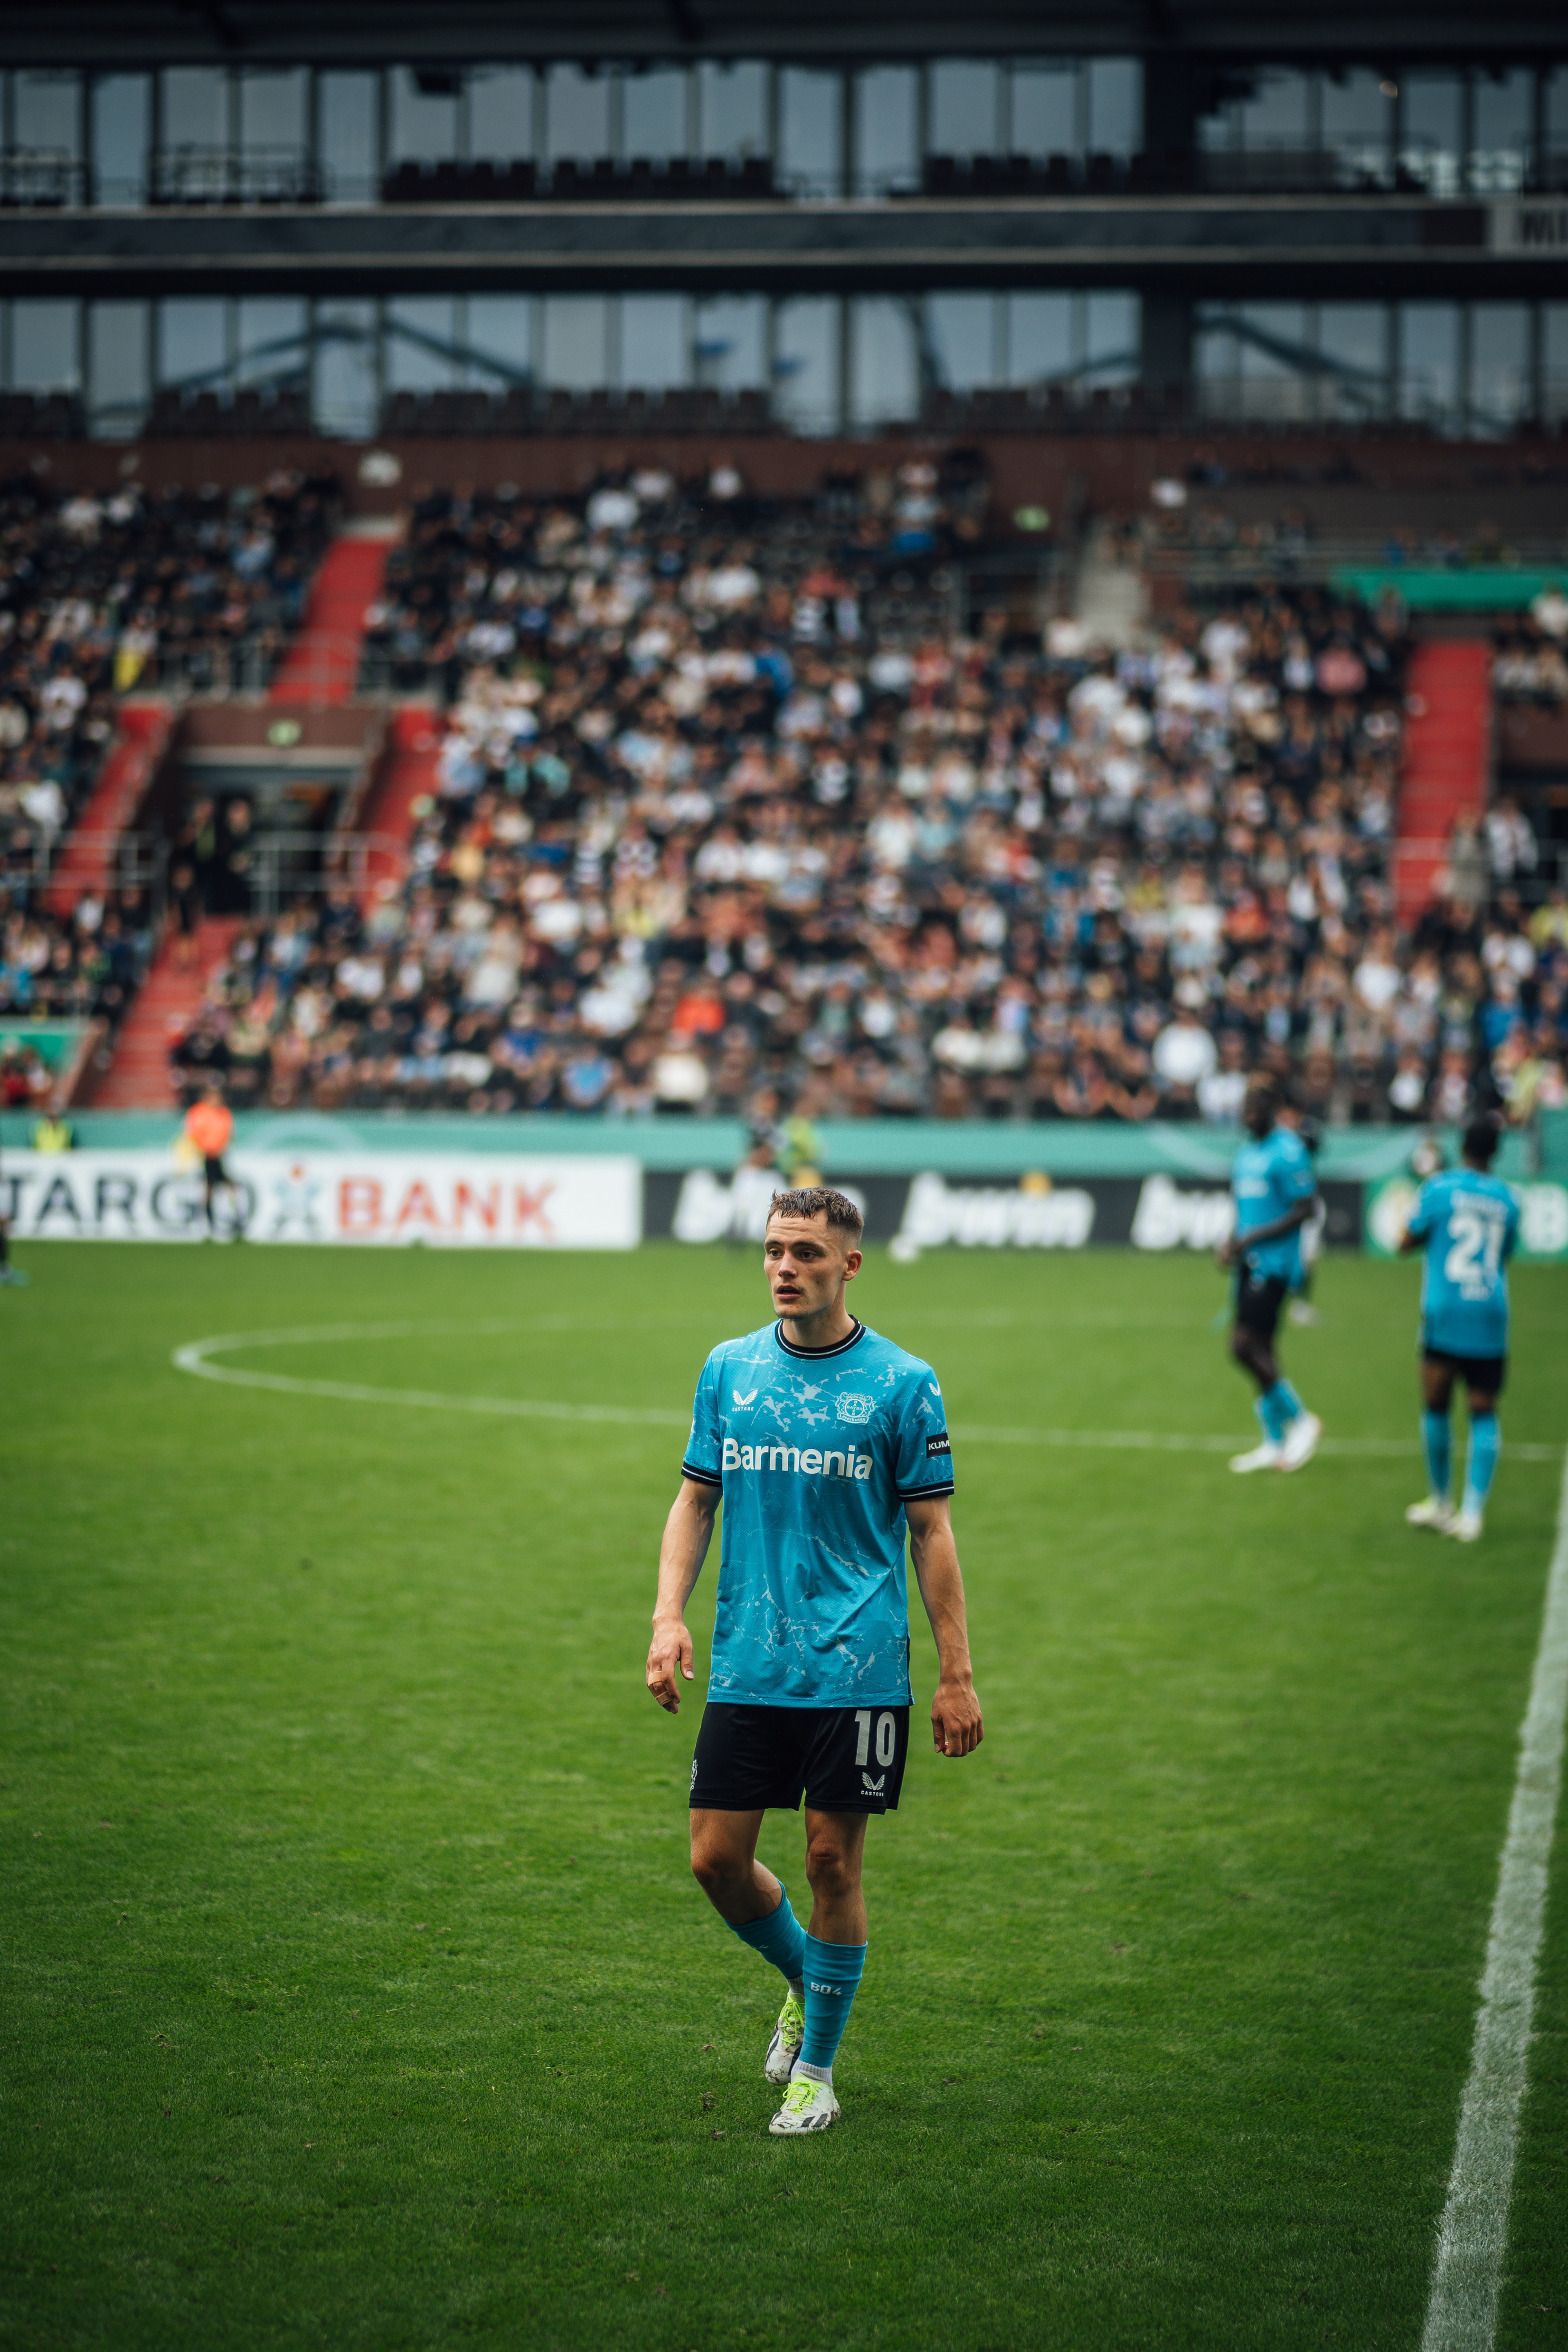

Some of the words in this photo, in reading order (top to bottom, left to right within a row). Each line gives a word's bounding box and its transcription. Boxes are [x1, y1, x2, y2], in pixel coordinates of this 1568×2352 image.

[335, 1176, 557, 1237] BANK
[1444, 1212, 1506, 1284] 21
[722, 1438, 873, 1480] Barmenia
[855, 1710, 895, 1766] 10
